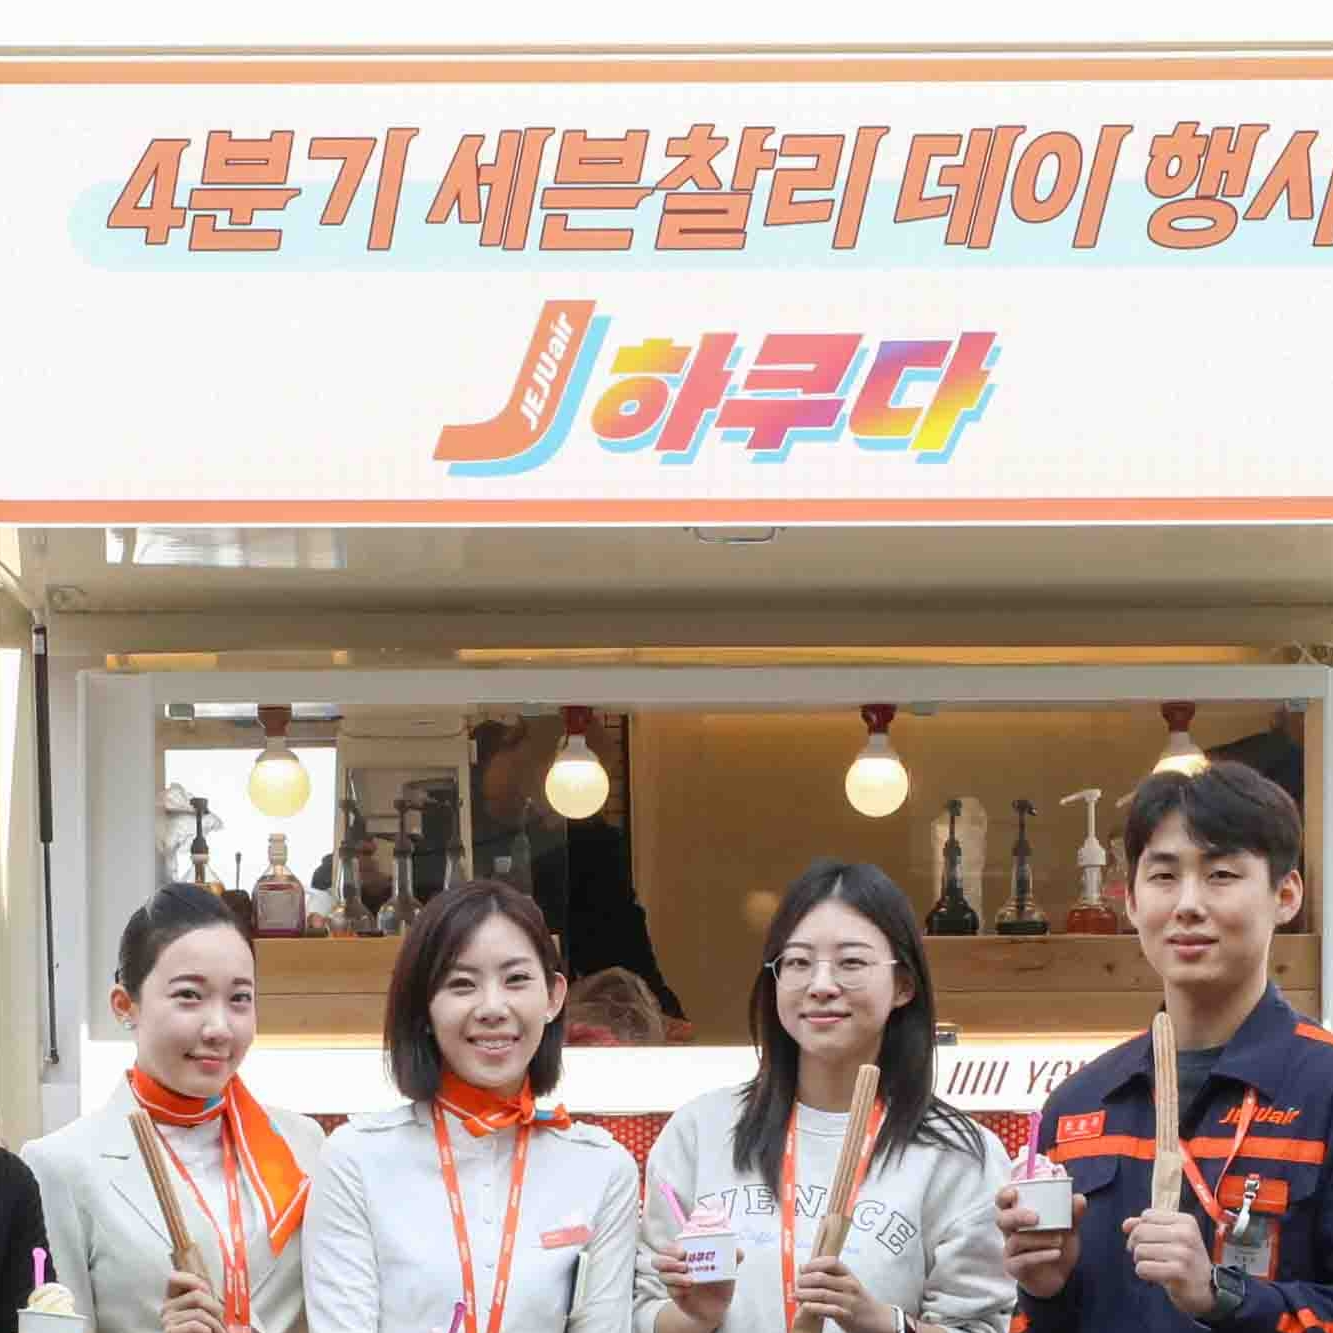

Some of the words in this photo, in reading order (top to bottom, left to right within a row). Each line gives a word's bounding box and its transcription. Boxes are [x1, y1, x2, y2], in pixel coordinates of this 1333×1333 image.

[106, 126, 420, 252] 4분기
[425, 123, 890, 251] 세븐찰리
[893, 124, 1134, 250] 데이
[518, 313, 575, 431] JEJUair
[697, 1183, 918, 1256] VENCE
